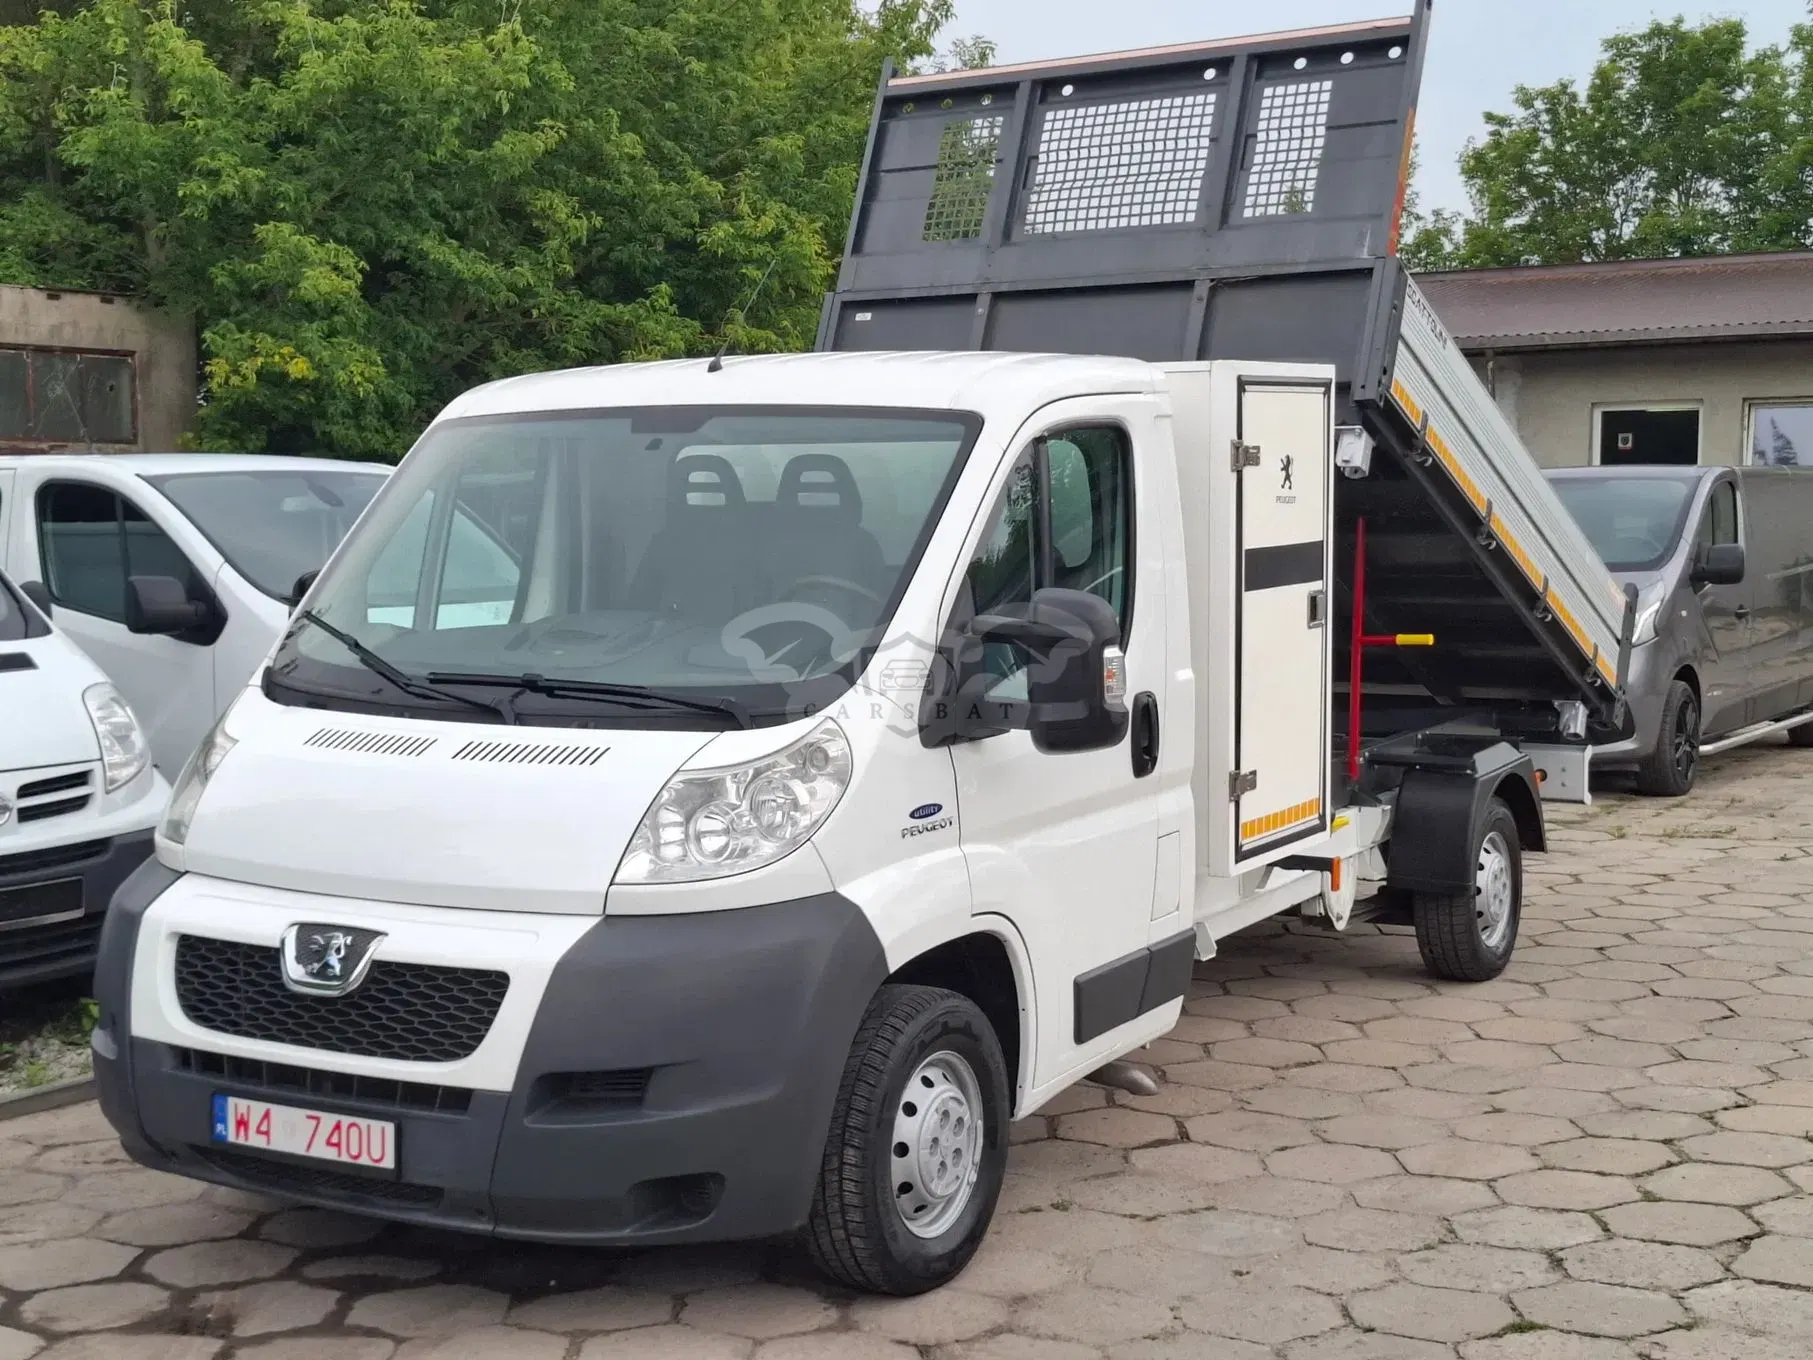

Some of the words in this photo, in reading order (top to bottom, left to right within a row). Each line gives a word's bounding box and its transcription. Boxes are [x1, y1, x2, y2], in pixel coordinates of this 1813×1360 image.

[901, 816, 953, 839] PEUGEOT
[234, 1103, 271, 1146] W4
[305, 1114, 386, 1163] 740U
